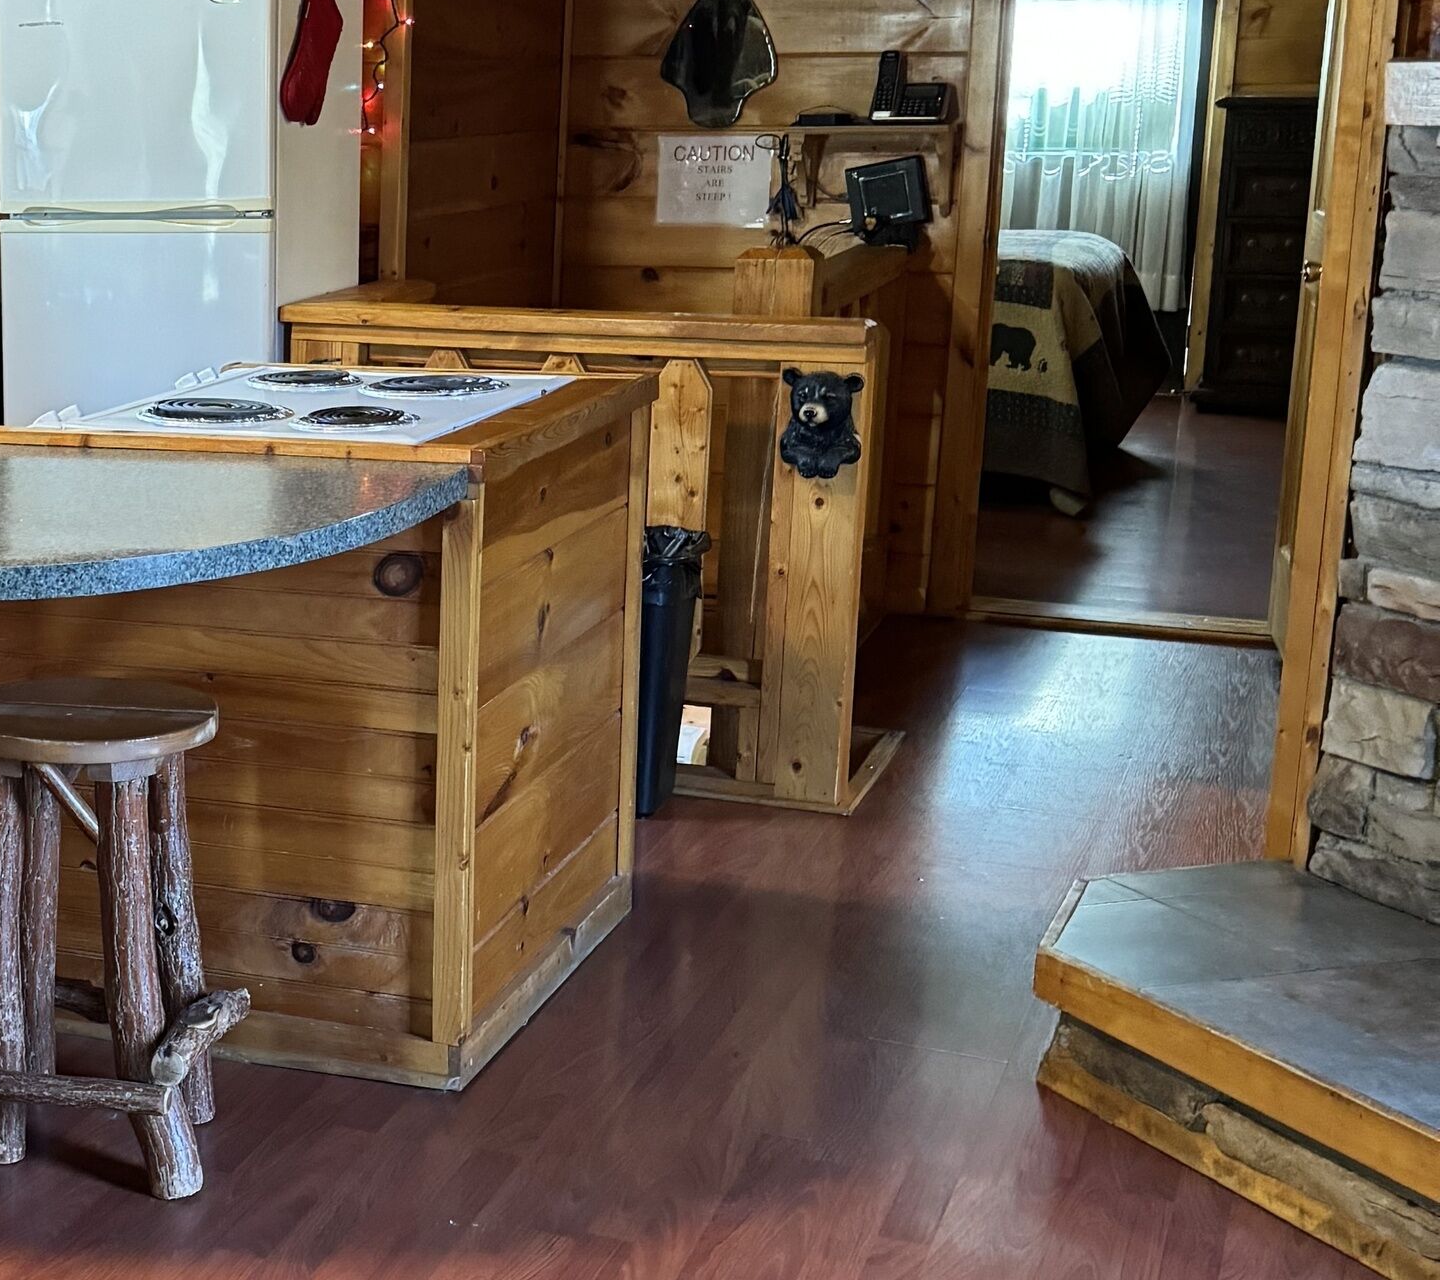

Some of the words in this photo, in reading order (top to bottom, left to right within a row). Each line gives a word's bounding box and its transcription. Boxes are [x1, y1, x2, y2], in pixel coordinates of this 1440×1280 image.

[673, 144, 755, 161] CAUTION
[697, 165, 733, 174] STAIRS
[706, 179, 724, 187] ARE
